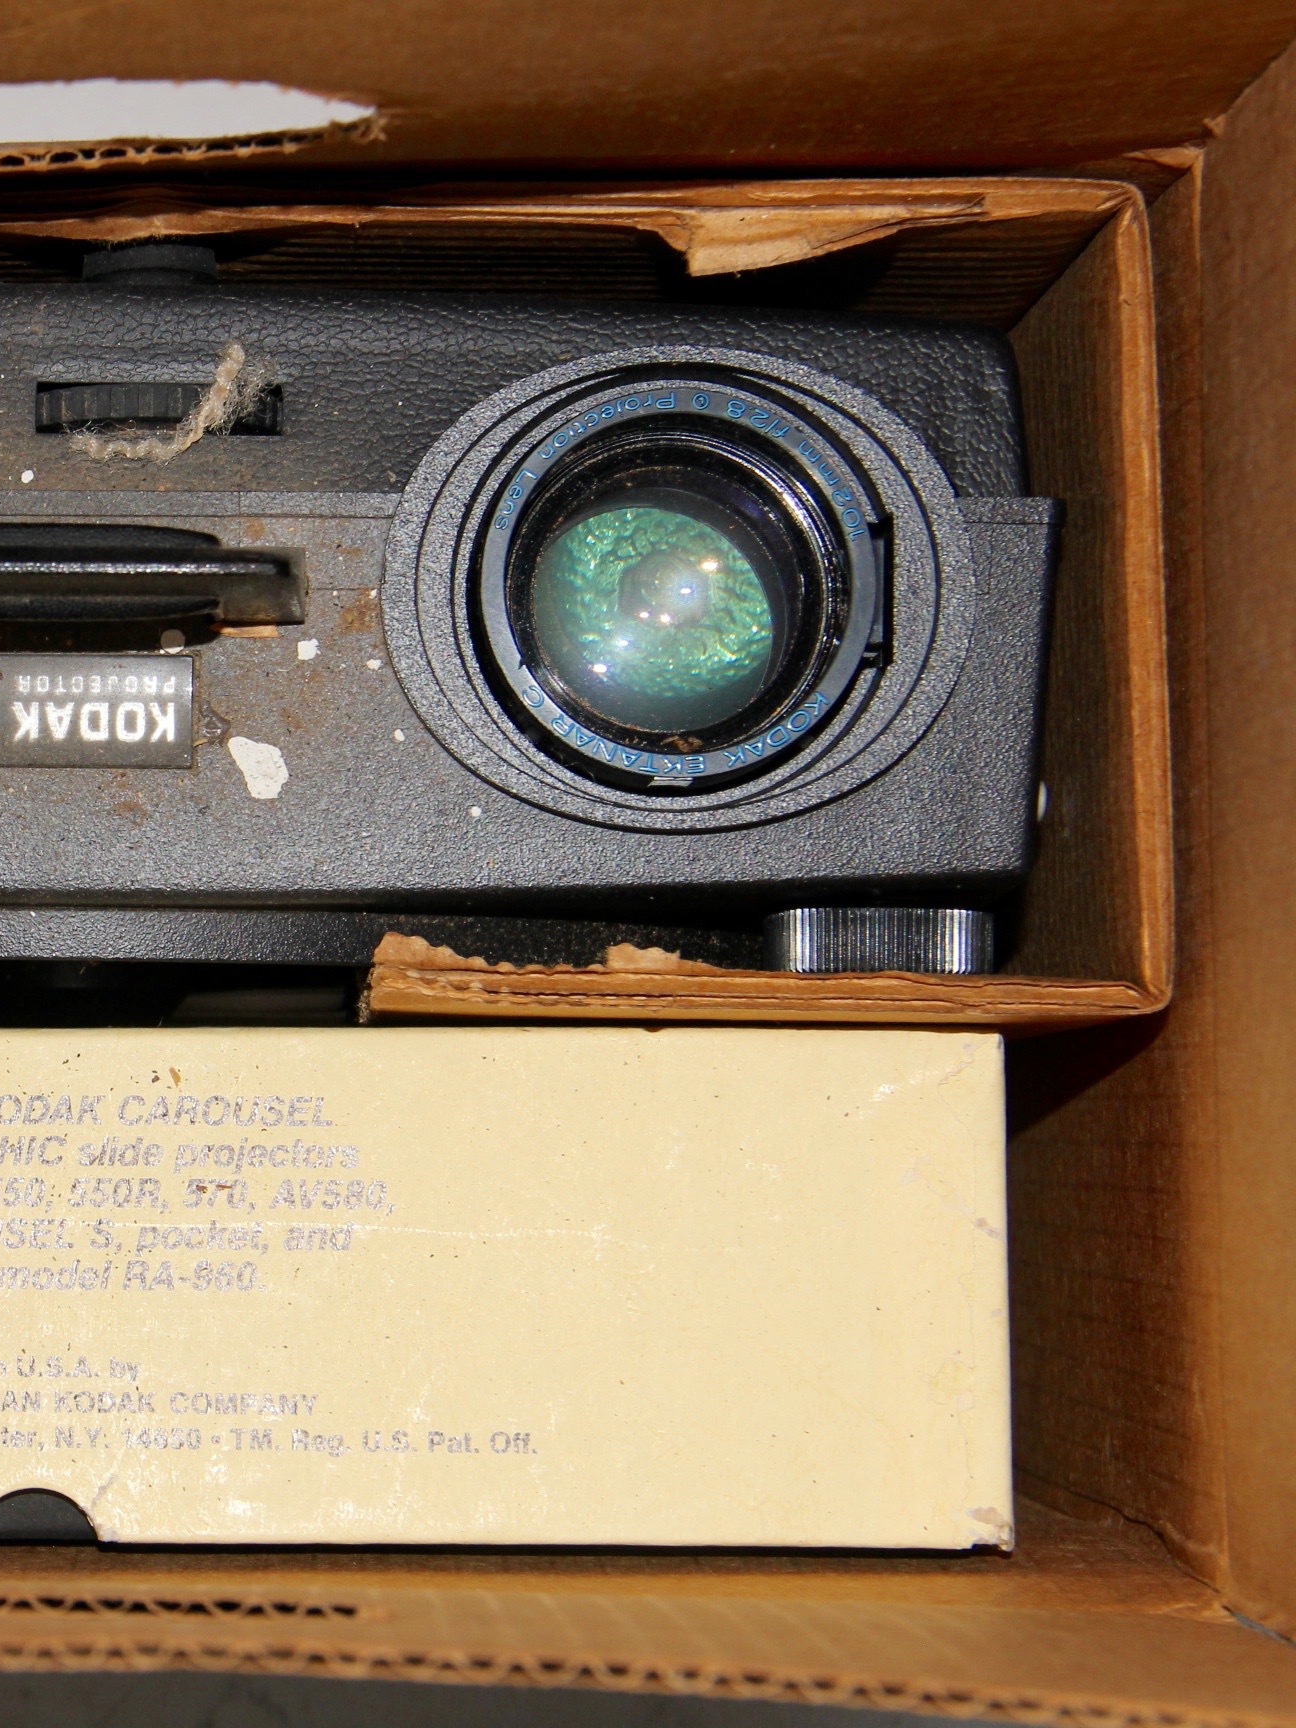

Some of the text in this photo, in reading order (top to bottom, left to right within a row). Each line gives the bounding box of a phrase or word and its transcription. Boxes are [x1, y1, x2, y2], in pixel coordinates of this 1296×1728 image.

[537, 391, 676, 460] Projection
[494, 469, 538, 531] Lens
[797, 439, 866, 542] 102mm
[17, 675, 175, 695] PROJECTOR
[13, 701, 176, 742] KODAK
[520, 684, 830, 775] KODAK EKTANAR C
[117, 1095, 334, 1127] CAROUSEL
[77, 1136, 165, 1168] slide
[173, 1136, 360, 1175] projectors
[68, 1177, 168, 1214] 550R,
[183, 1178, 256, 1215] 570,
[269, 1179, 396, 1216] AV580,
[90, 1218, 122, 1252] S,
[135, 1220, 268, 1257] pocket,
[283, 1222, 354, 1251] and
[17, 1355, 100, 1378] U.S.A.
[109, 1356, 140, 1383] by
[54, 1390, 156, 1414] KODAK
[170, 1391, 319, 1416] COMPANY
[55, 1426, 111, 1449] N.Y.
[122, 1427, 202, 1450] 14650
[230, 1428, 281, 1451] TM.
[291, 1429, 352, 1458] Reg.
[362, 1430, 418, 1454] U.S.
[428, 1431, 480, 1455] Pat.
[489, 1431, 539, 1455] Off.
